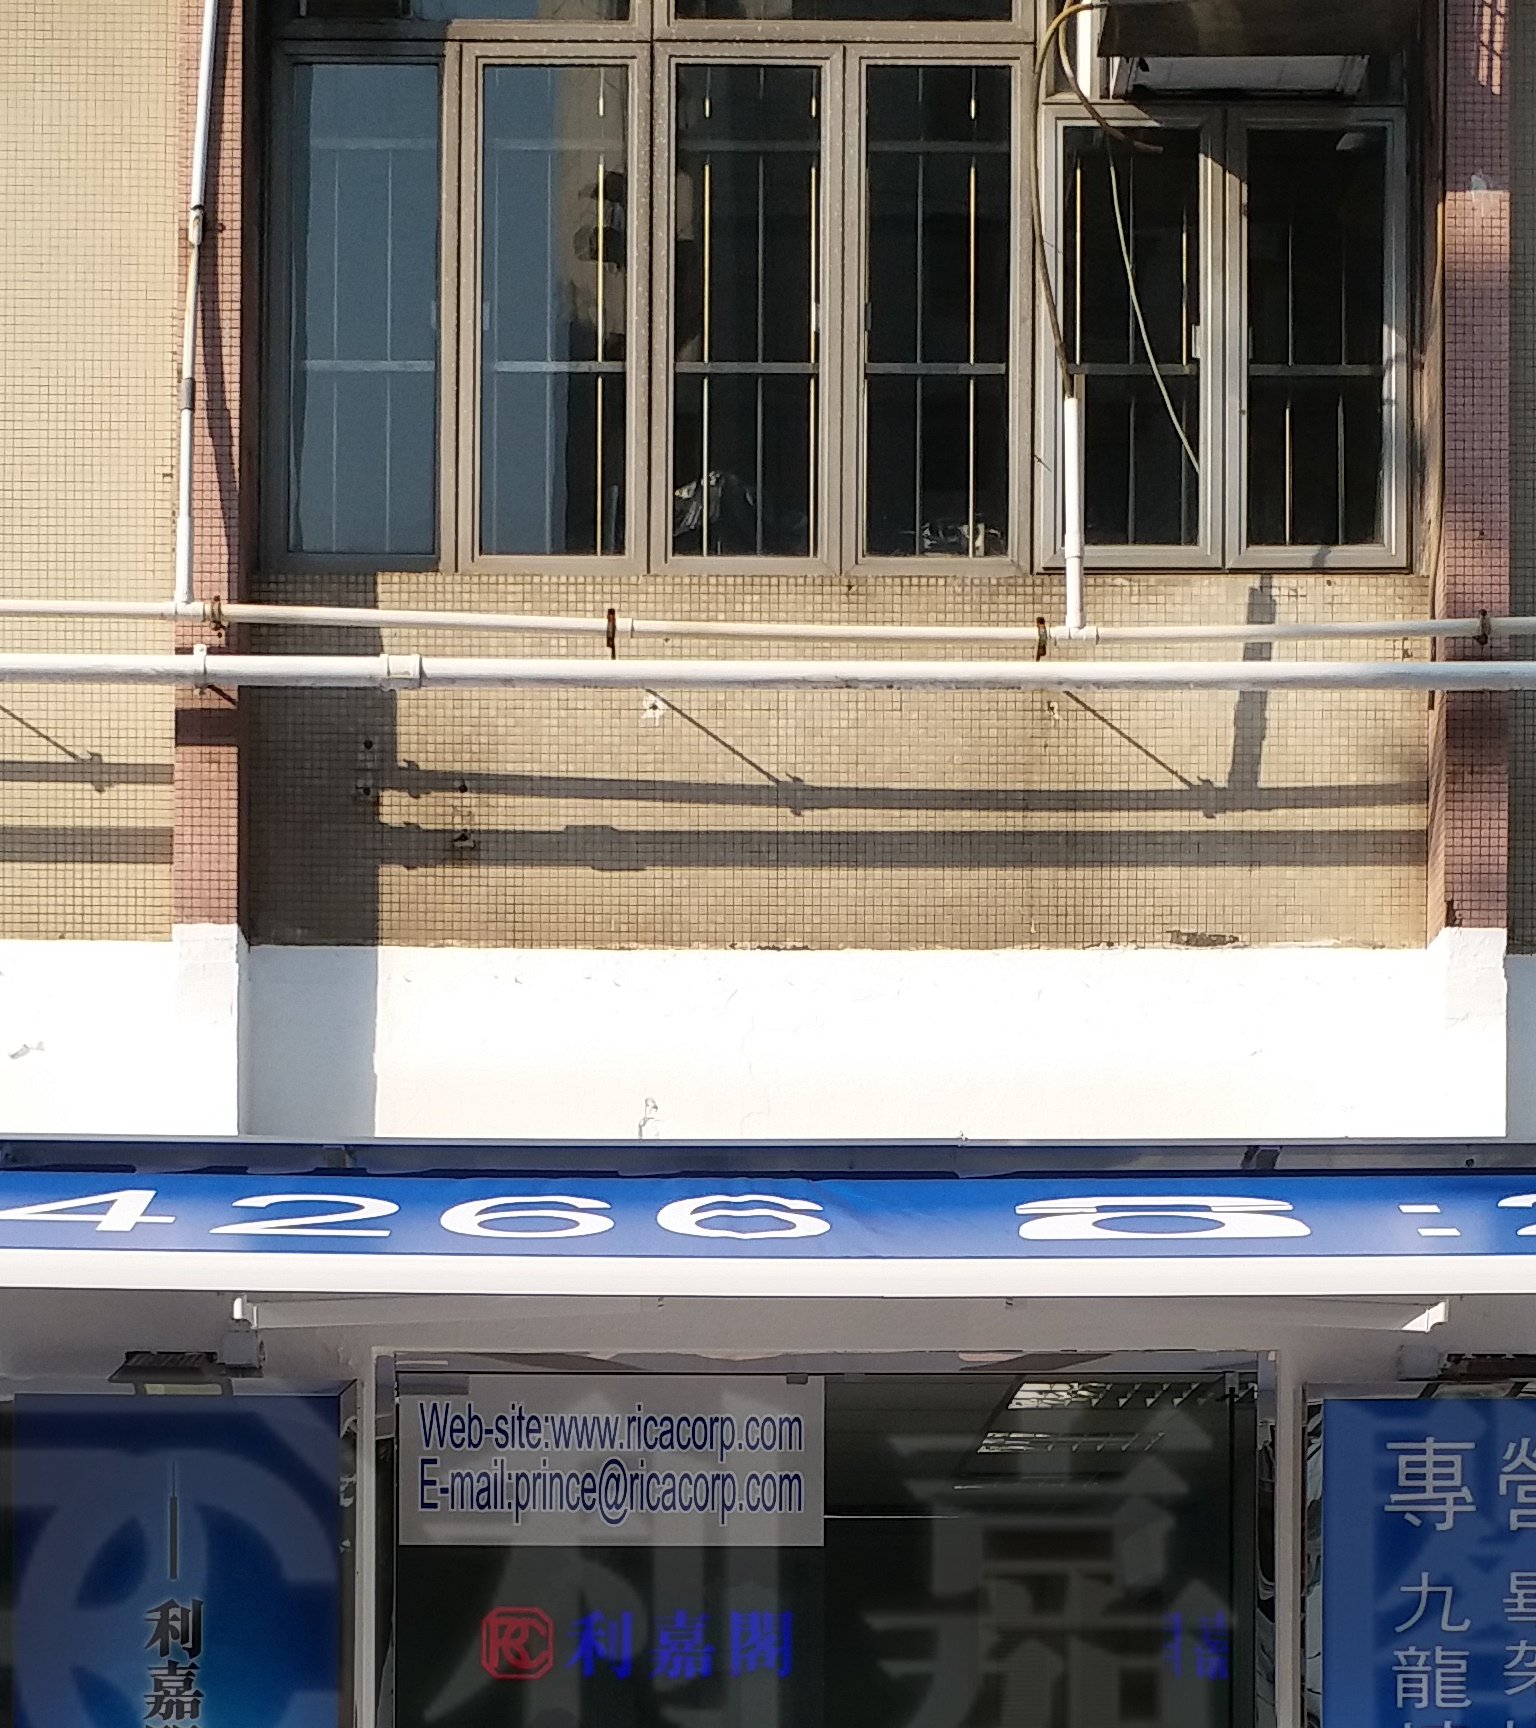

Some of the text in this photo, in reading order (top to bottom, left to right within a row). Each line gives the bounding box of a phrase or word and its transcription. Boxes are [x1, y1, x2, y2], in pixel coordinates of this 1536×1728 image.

[420, 1402, 804, 1462] Web-site:www.ricacorp.com
[420, 1458, 804, 1525] E-mail:prince@ricacorp.com
[565, 1610, 793, 1679] 利嘉閣
